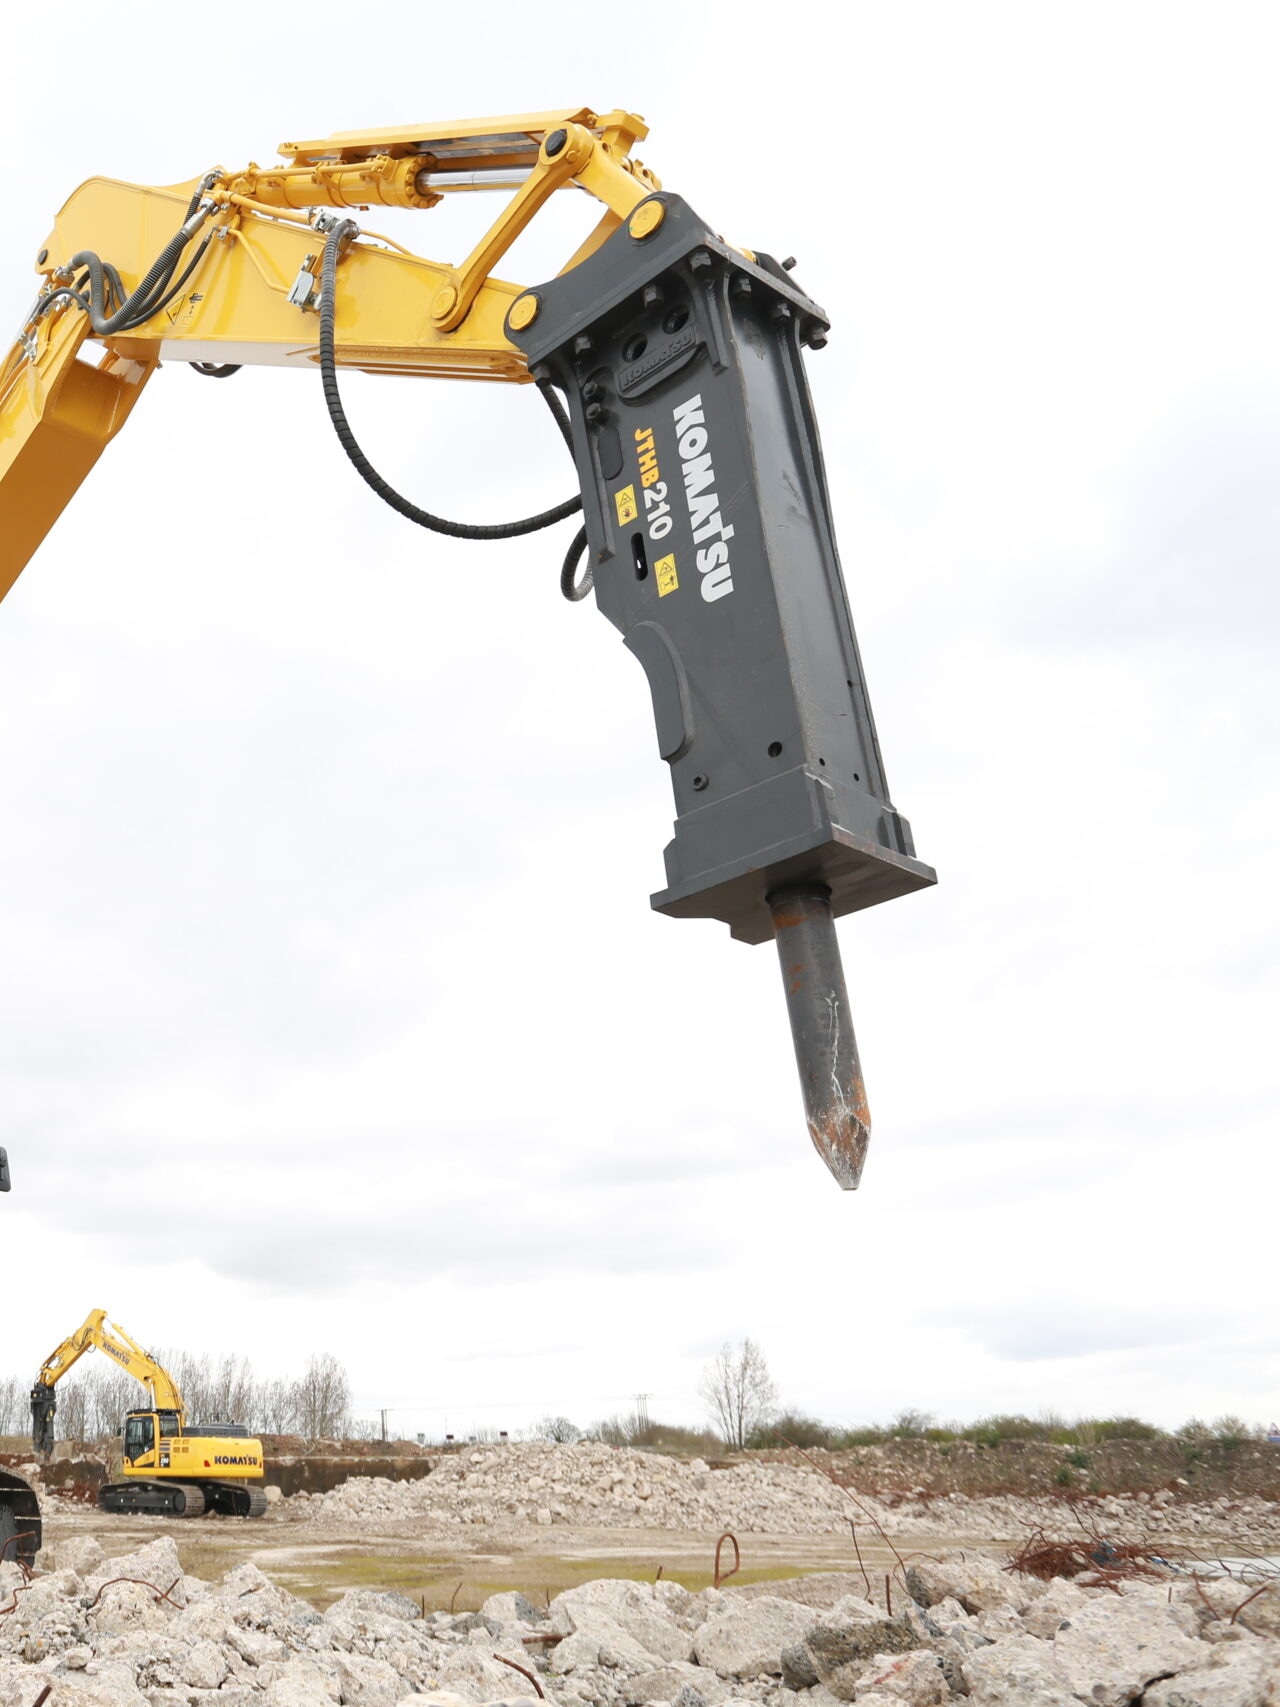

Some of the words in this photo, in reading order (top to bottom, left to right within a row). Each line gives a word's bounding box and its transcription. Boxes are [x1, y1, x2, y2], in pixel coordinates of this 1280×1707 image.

[634, 427, 673, 540] JTHB210
[673, 393, 735, 604] KOMATSU
[214, 1454, 258, 1466] KOMATSU
